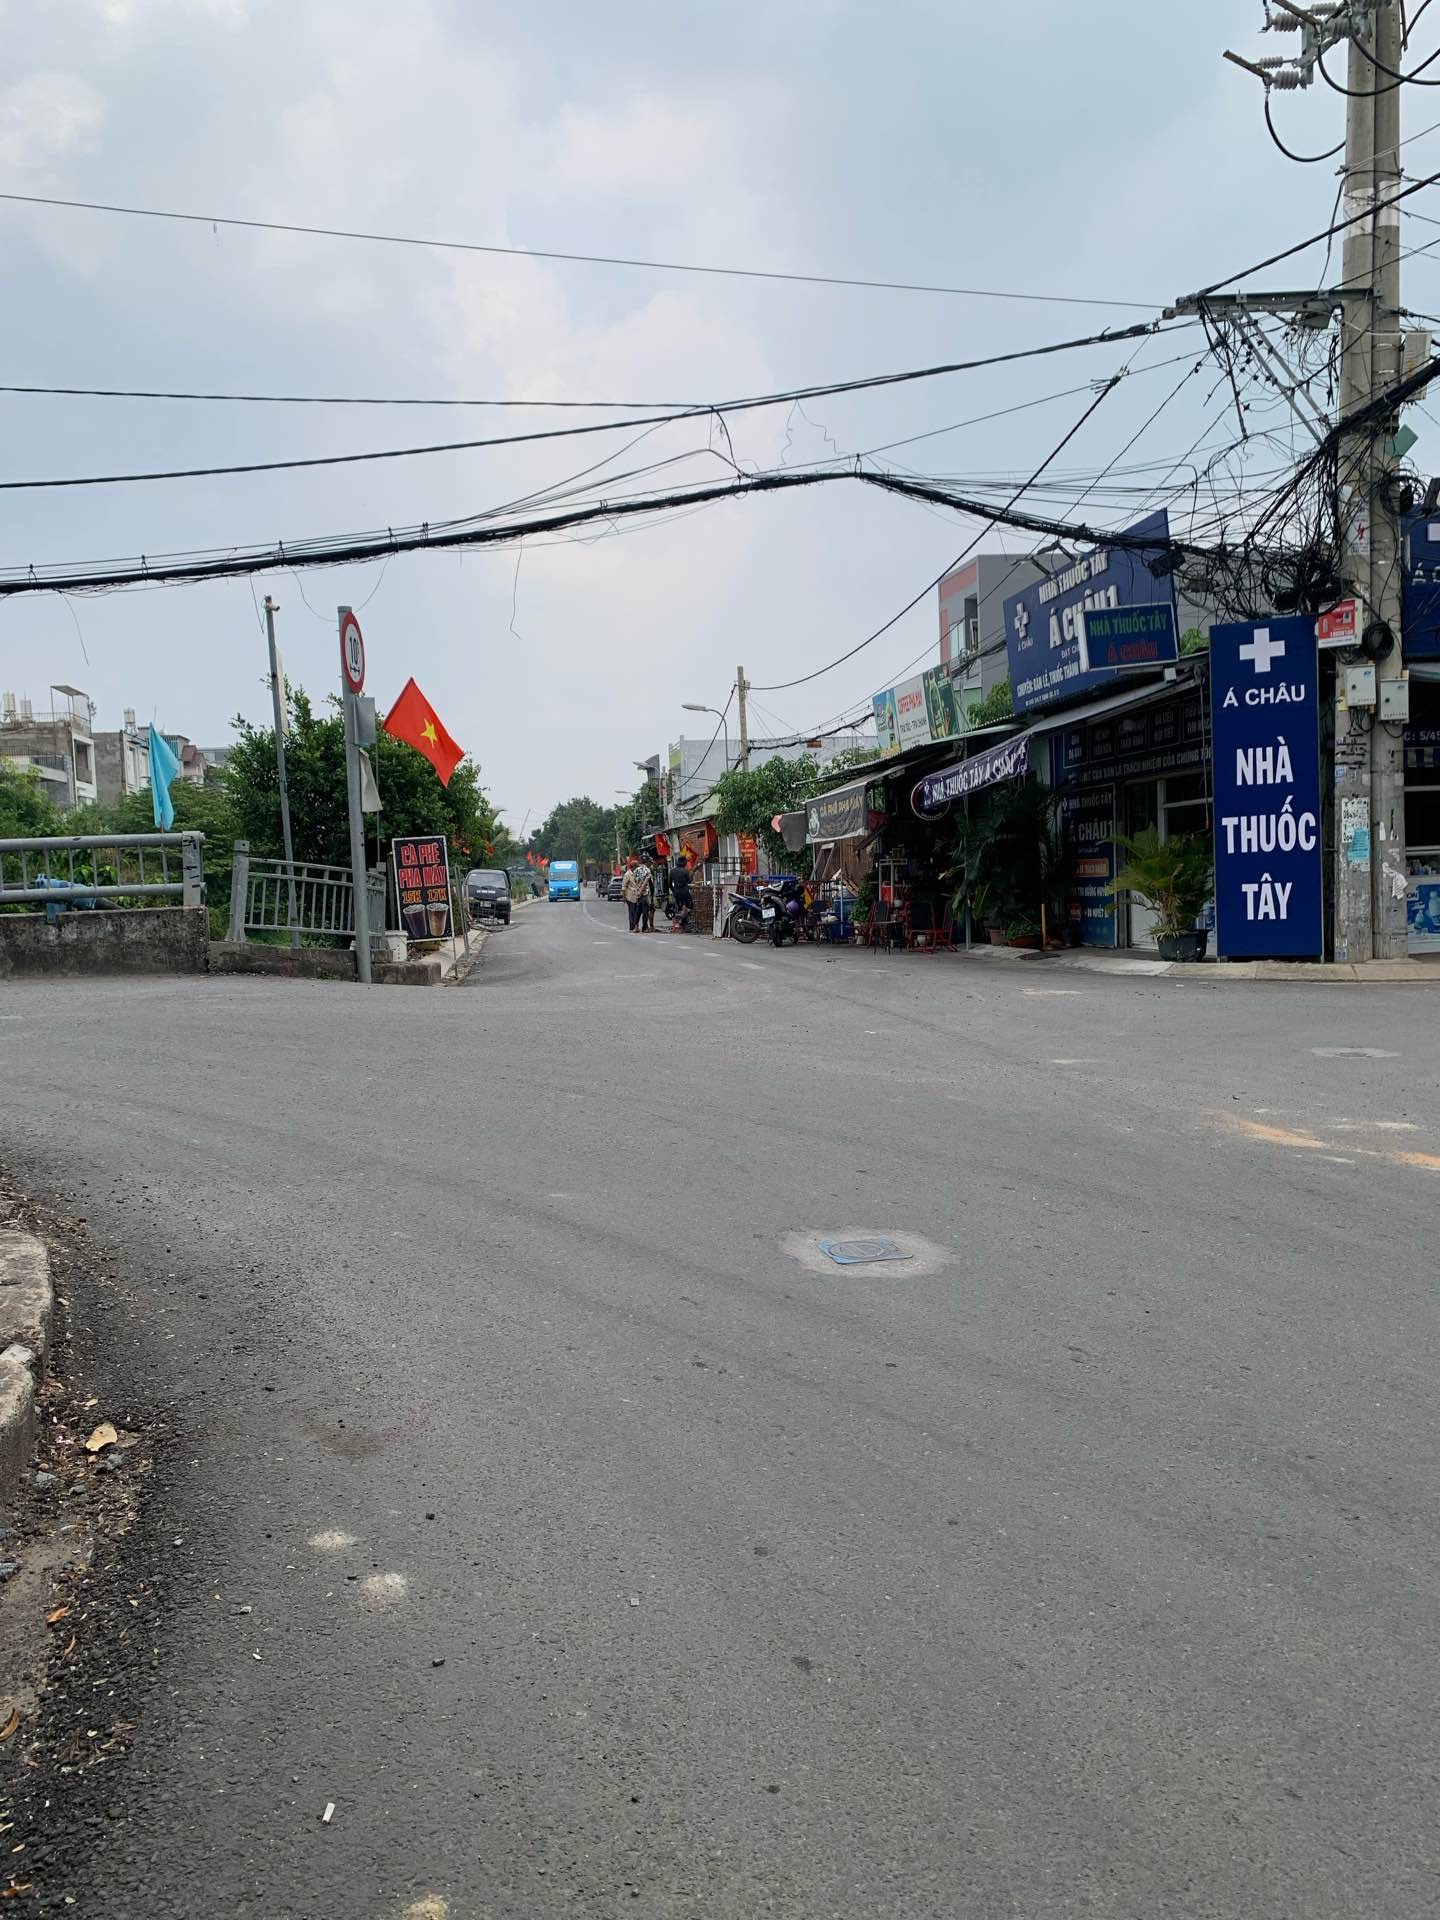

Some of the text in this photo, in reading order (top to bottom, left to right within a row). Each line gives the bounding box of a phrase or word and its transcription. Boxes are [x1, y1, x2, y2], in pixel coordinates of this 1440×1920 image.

[1057, 556, 1089, 596] THUỐC
[1090, 549, 1109, 577] TÂY
[1049, 607, 1063, 649] Á
[1089, 609, 1168, 637] NHÀ THUỐC TÂY
[1222, 682, 1305, 708] Á CHÂU
[1236, 736, 1294, 786] NHÀ
[946, 764, 969, 799] THUỐC
[969, 762, 985, 789] TÂY
[1221, 795, 1316, 854] THUỐC
[401, 842, 441, 866] CÀ PHÊ
[399, 864, 447, 888] PHA MÁY
[402, 888, 448, 904] 15K 17K
[1242, 873, 1292, 921] TÂY
